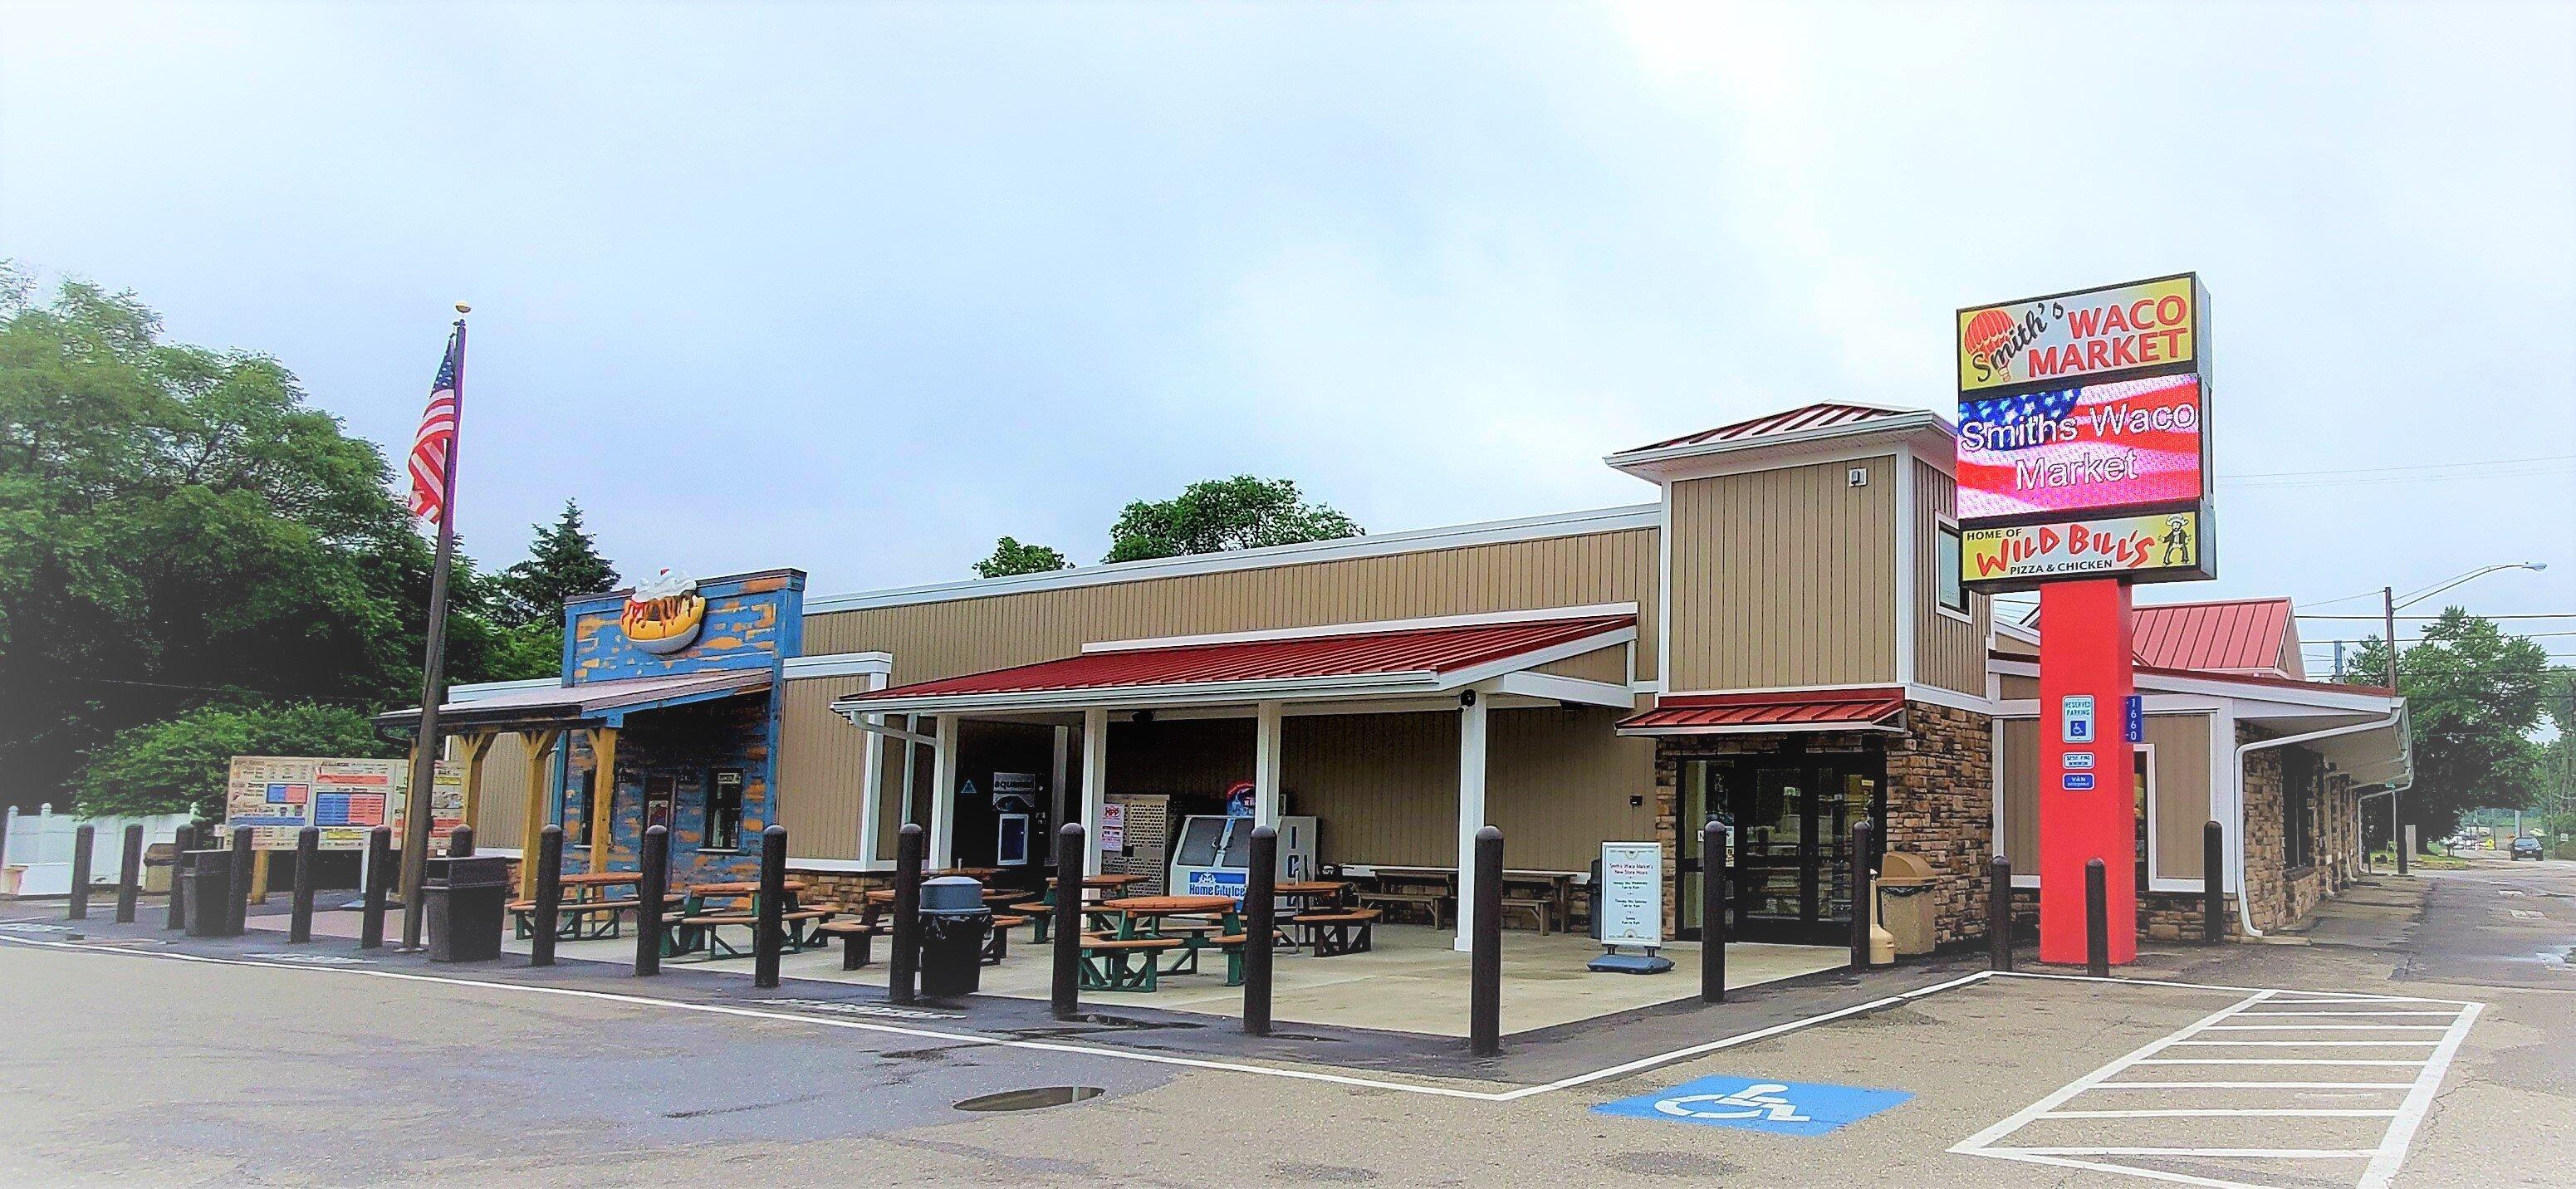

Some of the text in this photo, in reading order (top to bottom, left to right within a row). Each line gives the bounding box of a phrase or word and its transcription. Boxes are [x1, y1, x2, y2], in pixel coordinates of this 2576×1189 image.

[2068, 295, 2188, 340] WACO
[1971, 301, 2064, 382] Smith's
[2028, 327, 2188, 378] MARKET
[1961, 404, 2196, 452] Smiths Waco
[2015, 448, 2138, 492] Market
[1966, 527, 2023, 541] HOME OF
[1976, 524, 2156, 577] WILD BILL'S
[2010, 559, 2113, 575] PIZZA & CHICKEN
[1189, 883, 1246, 898] Home City Ice
